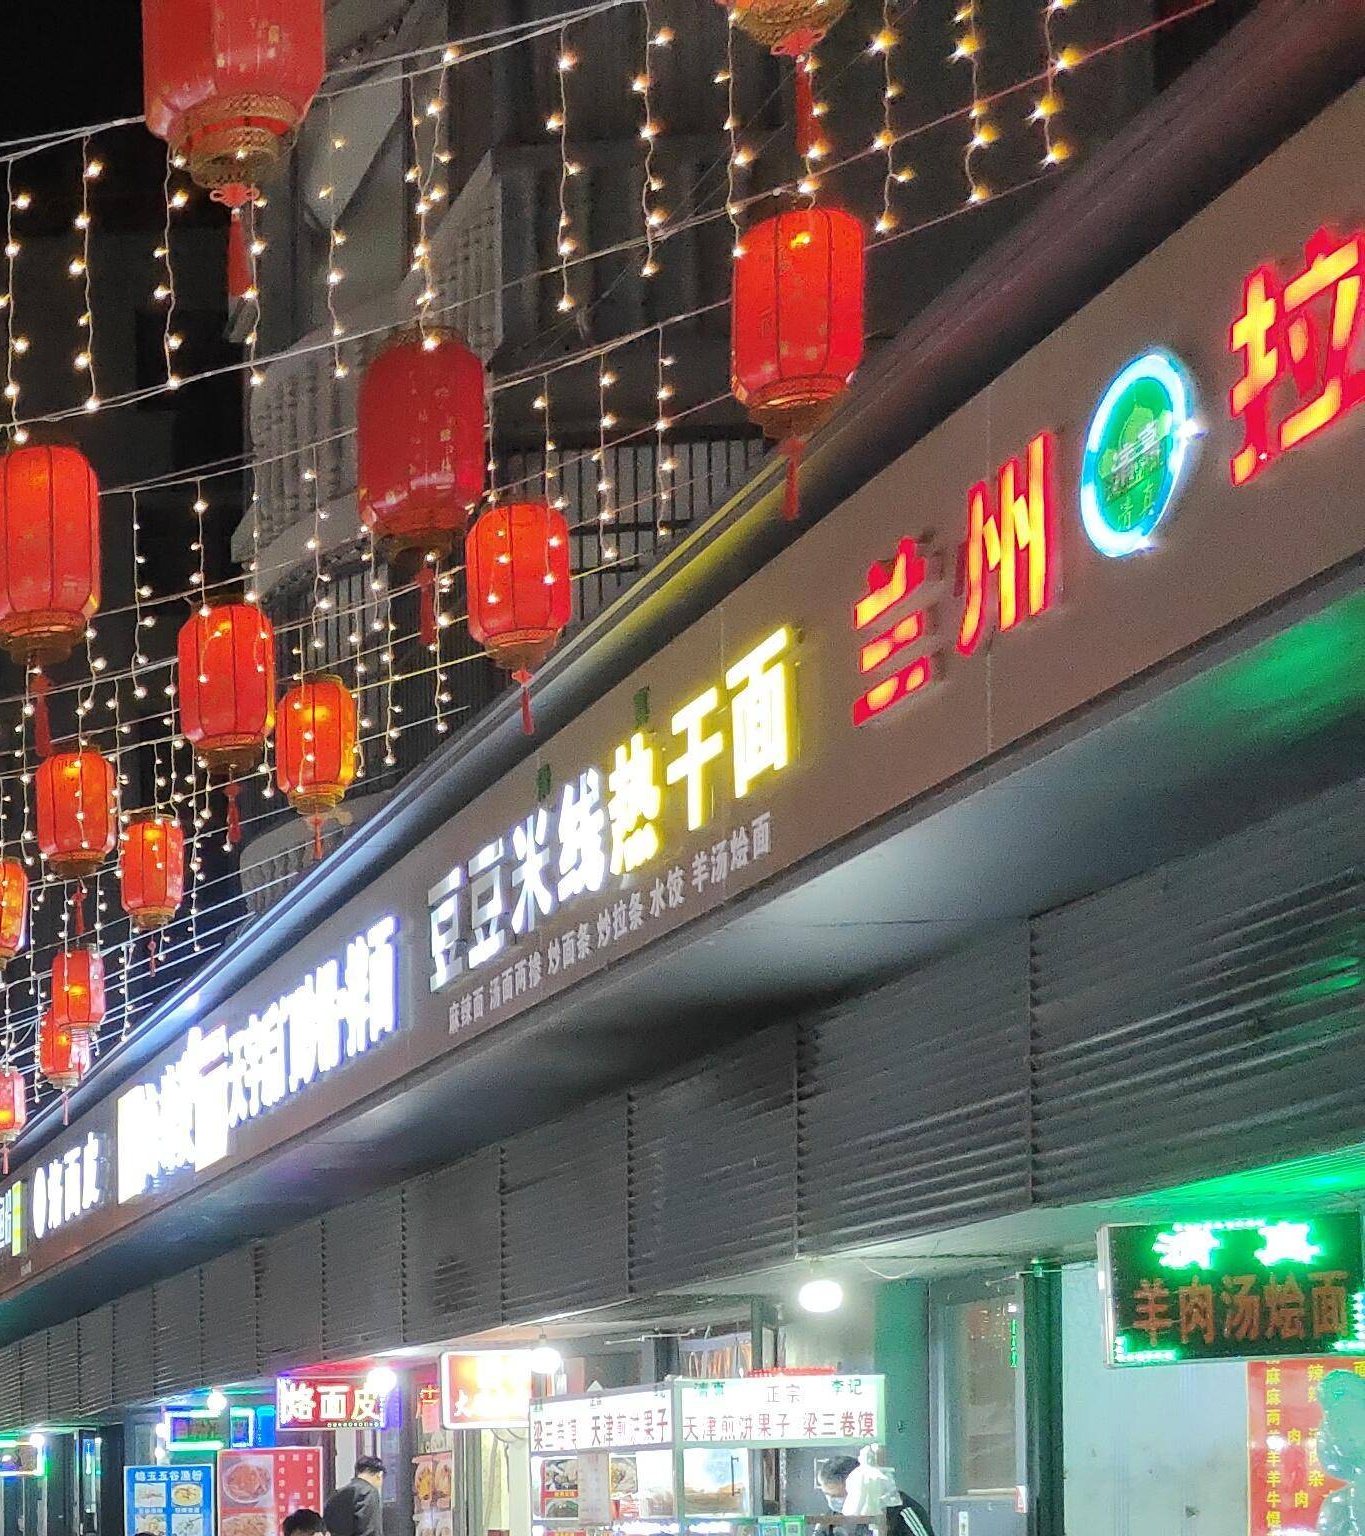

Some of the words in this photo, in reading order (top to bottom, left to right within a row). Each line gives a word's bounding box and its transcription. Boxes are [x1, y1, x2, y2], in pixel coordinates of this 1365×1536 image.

[1229, 226, 1365, 486] 拉
[853, 431, 1053, 727] 兰州
[1132, 1270, 1348, 1347] 羊肉汤烩面
[767, 1384, 801, 1403] 正宗
[683, 1413, 790, 1441] 天津煎饼果子
[803, 1411, 875, 1438] 梁三卷馍
